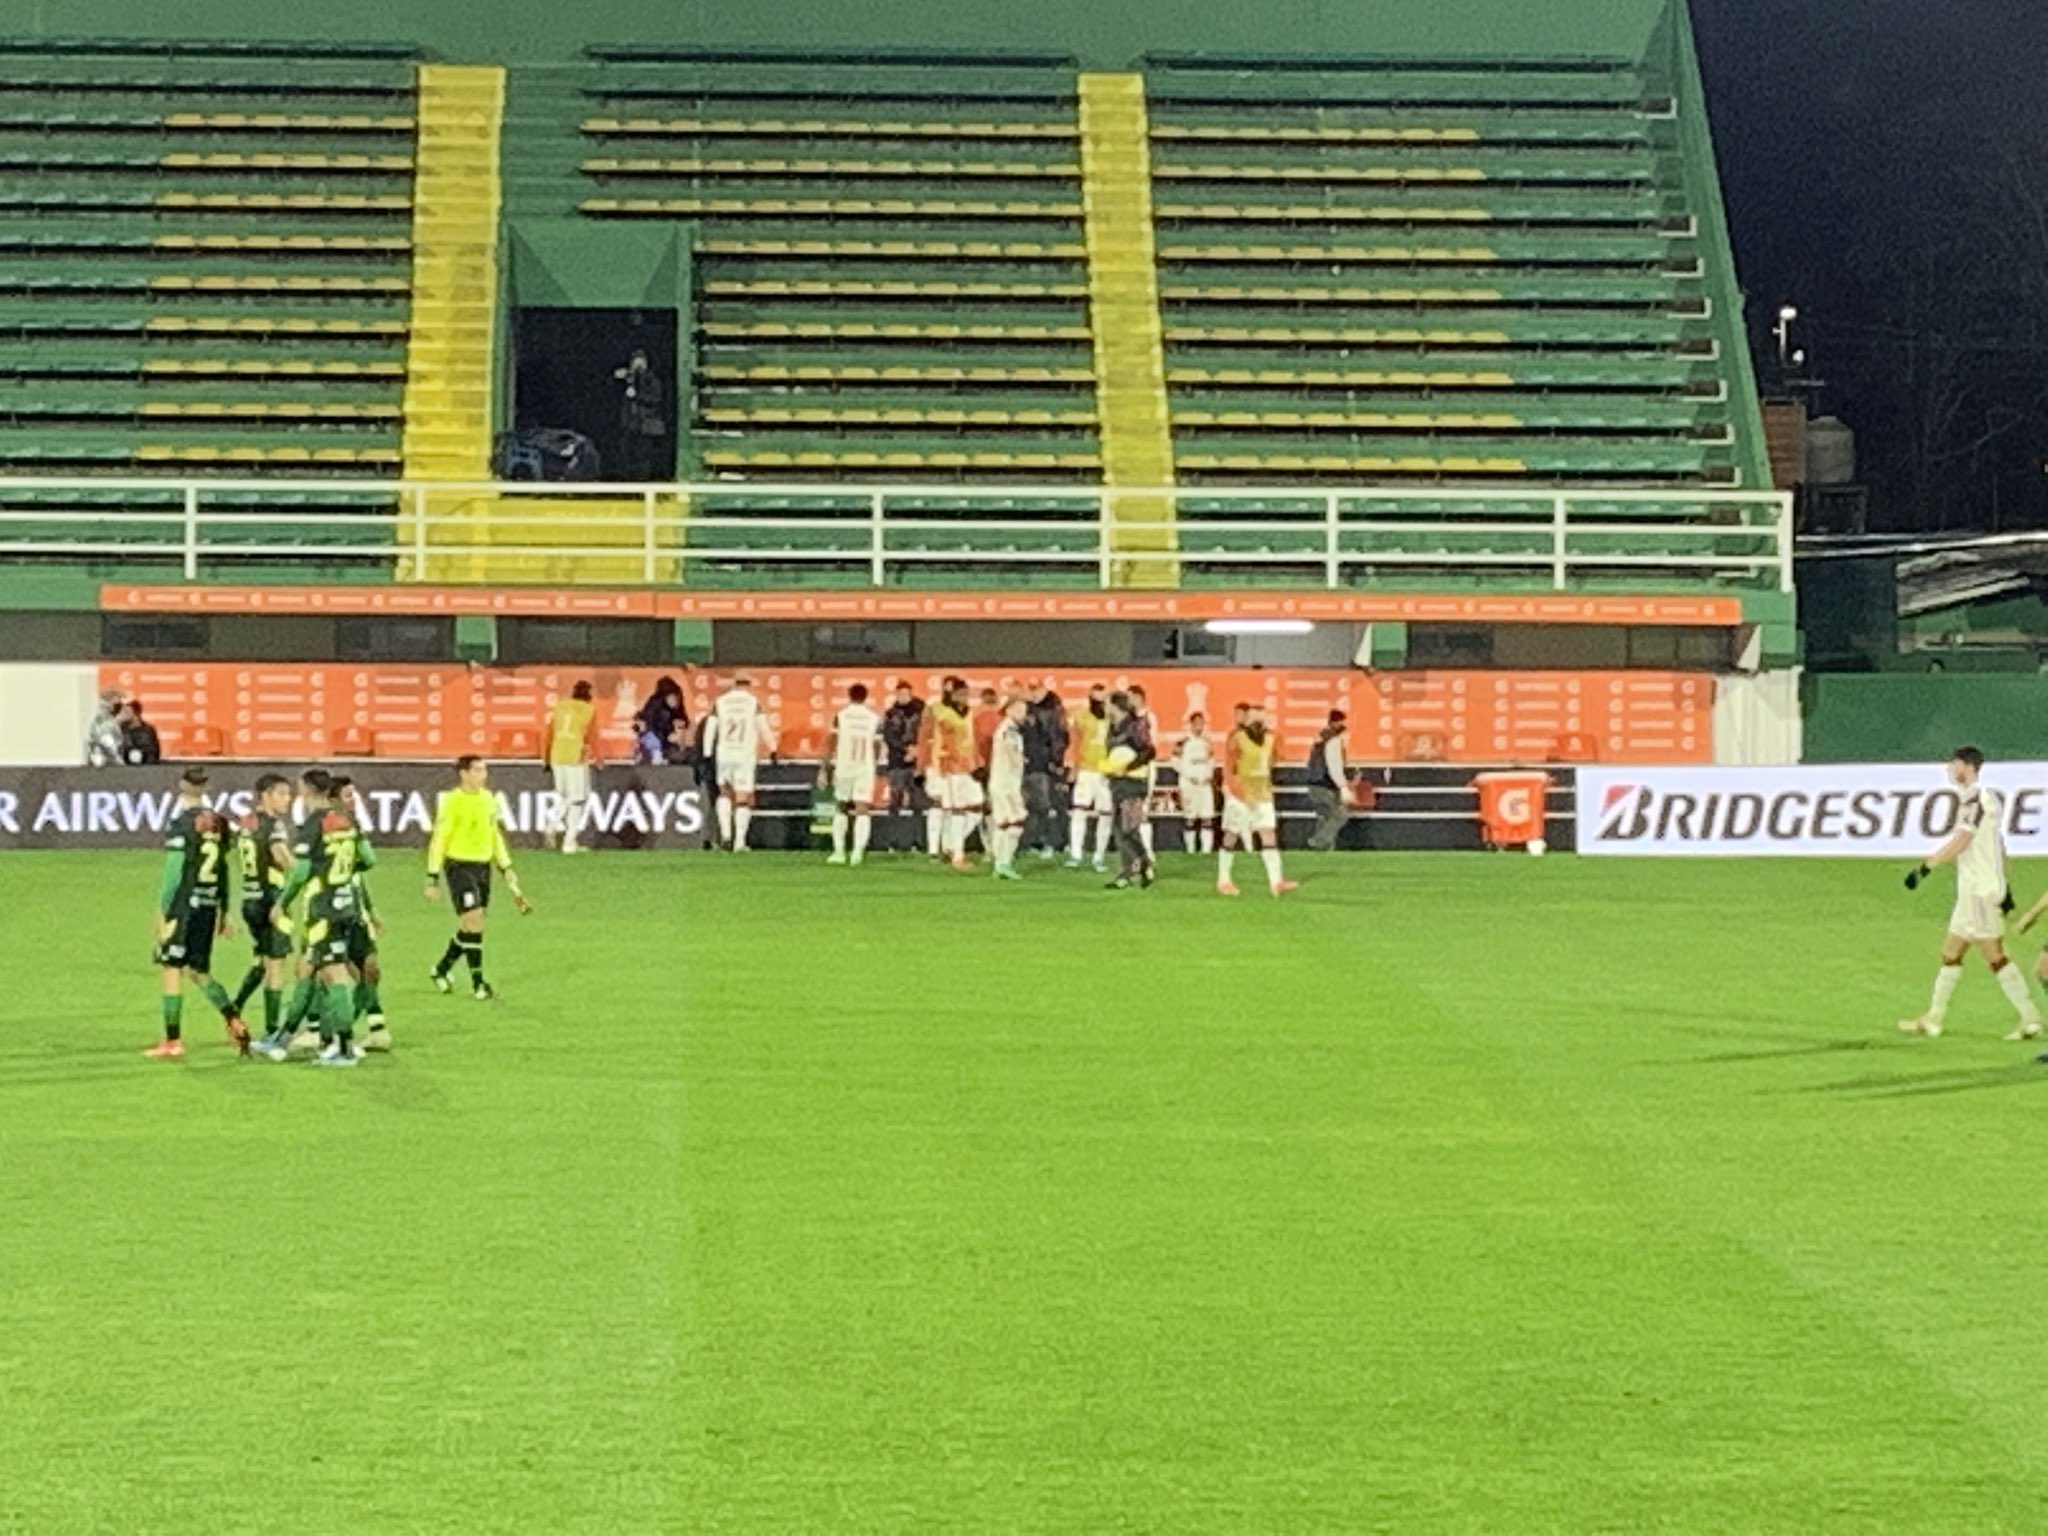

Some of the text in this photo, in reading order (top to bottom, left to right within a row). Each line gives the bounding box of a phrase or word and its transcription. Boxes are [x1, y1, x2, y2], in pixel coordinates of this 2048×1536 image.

[725, 717, 748, 744] 21
[1498, 788, 1530, 825] G
[1596, 784, 2044, 841] BRIDGESTOE
[198, 841, 219, 884] 2
